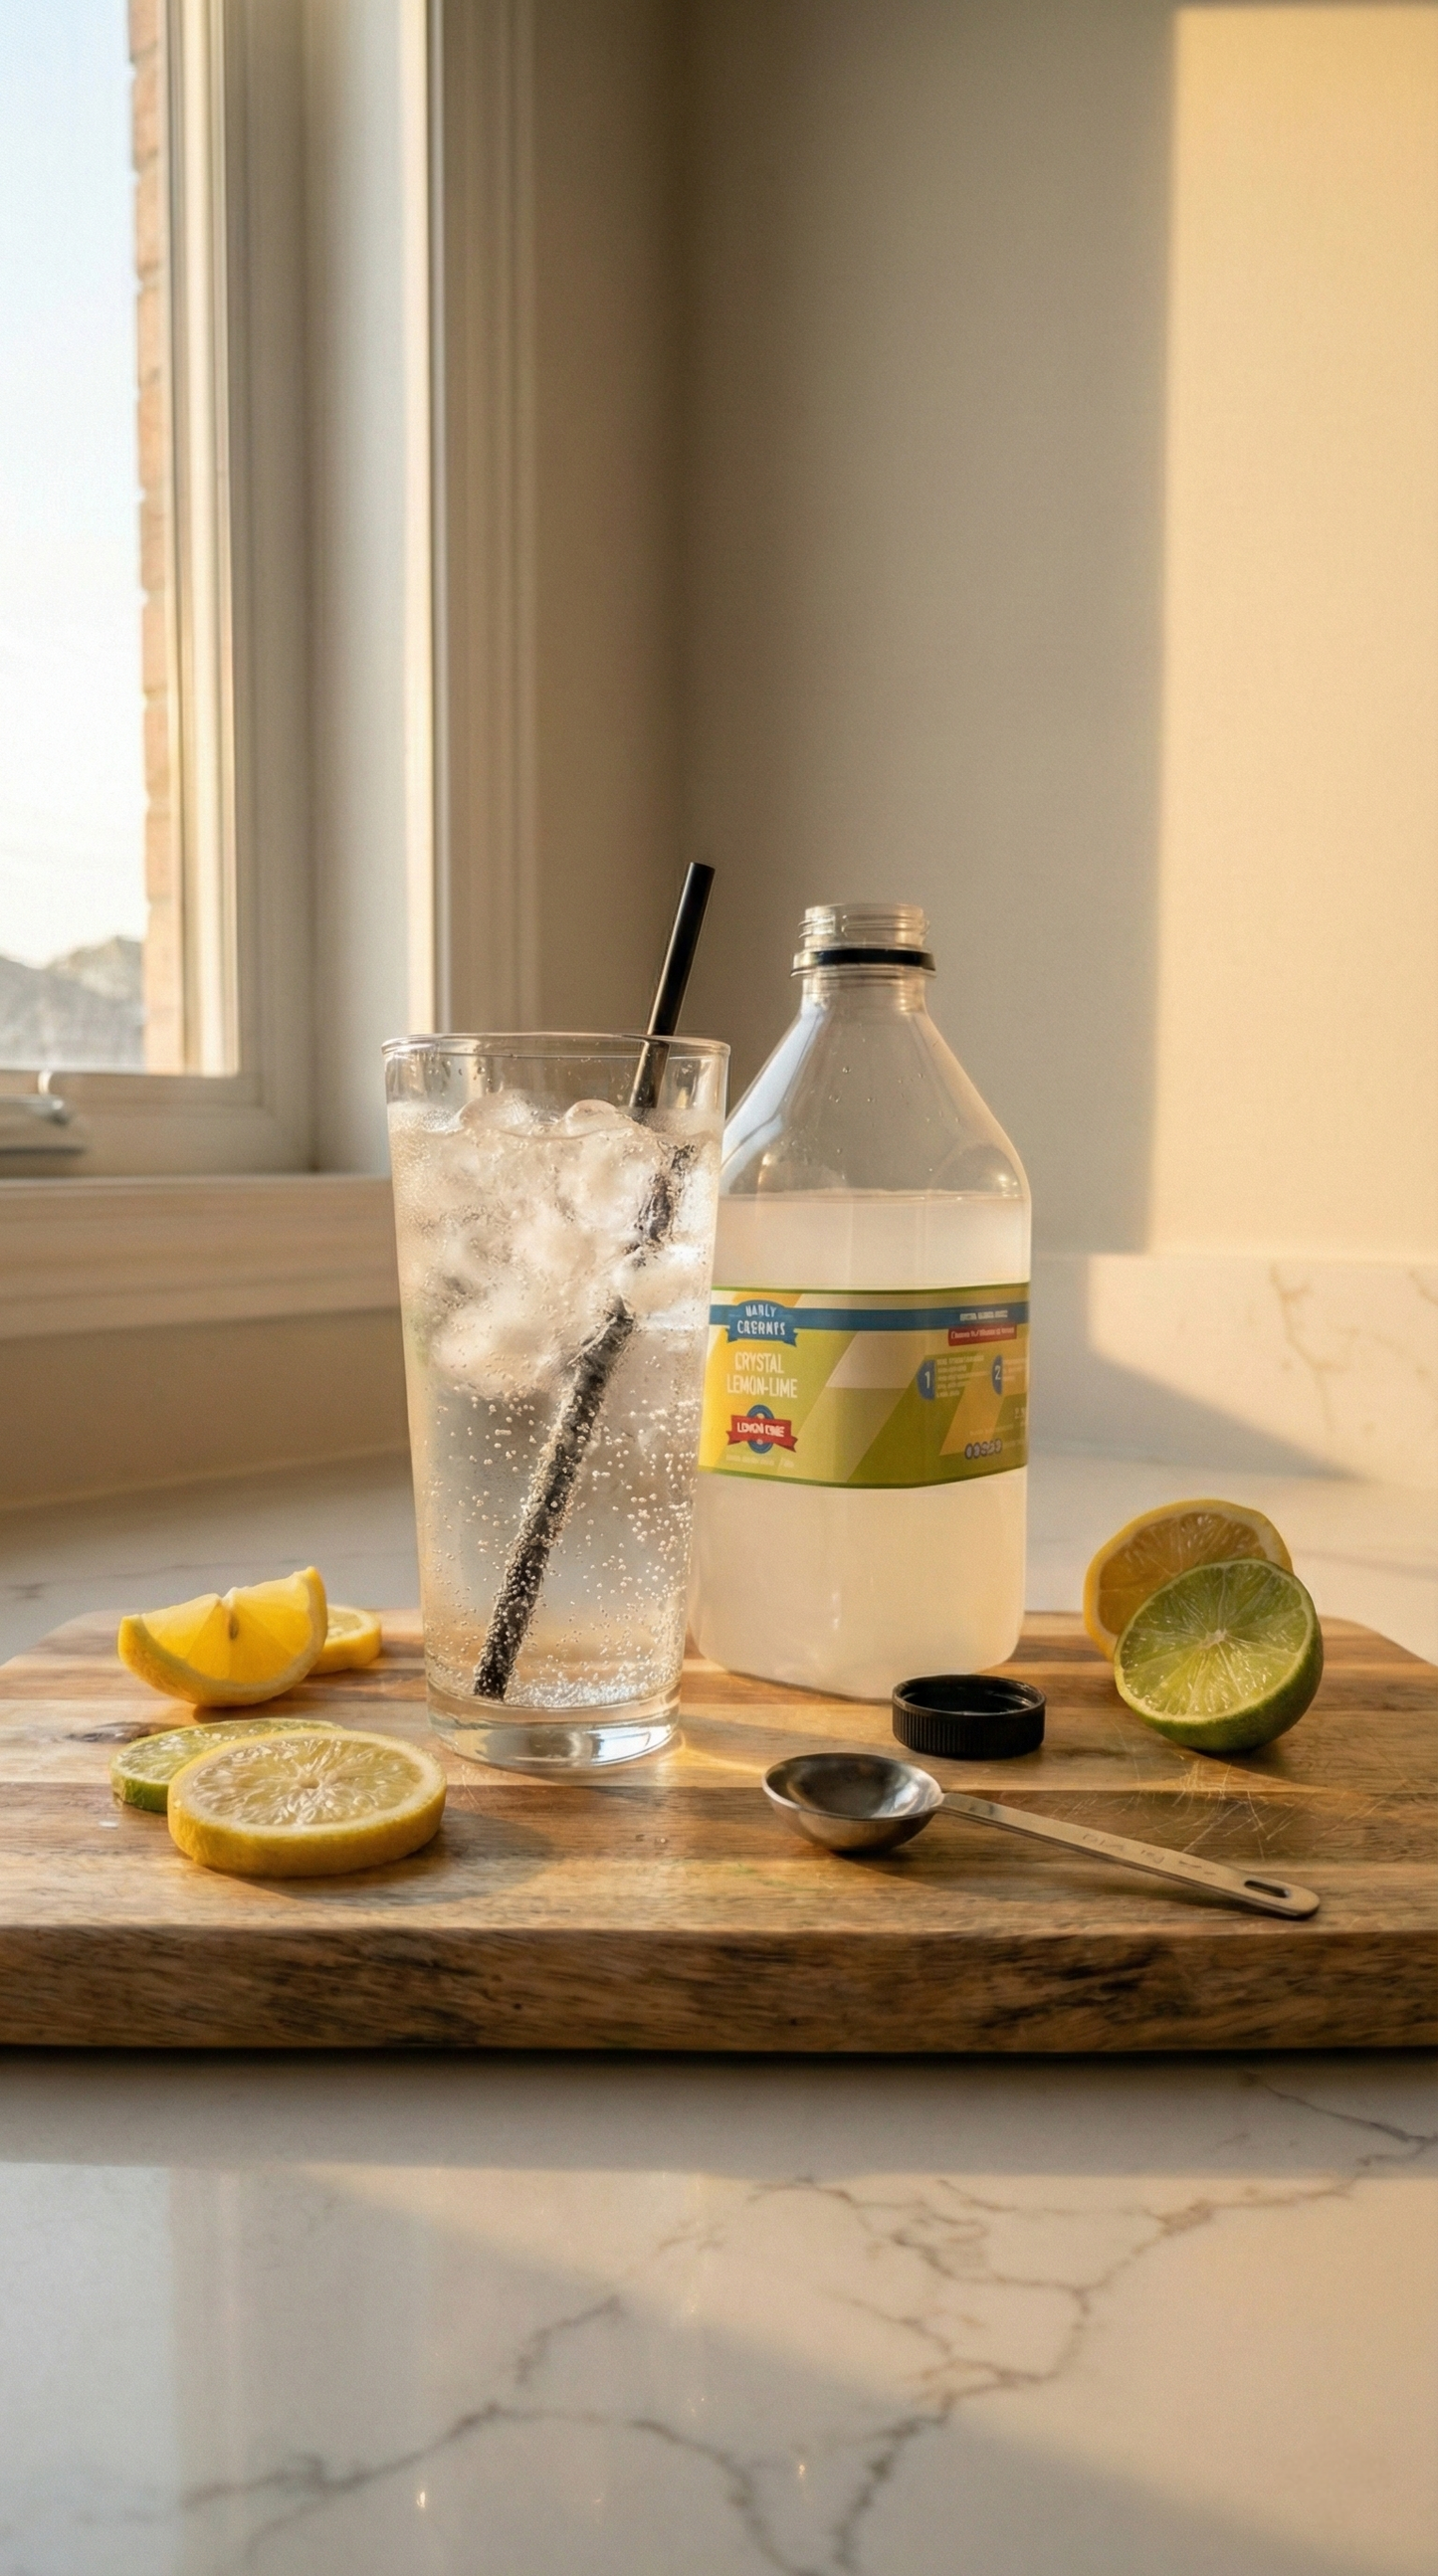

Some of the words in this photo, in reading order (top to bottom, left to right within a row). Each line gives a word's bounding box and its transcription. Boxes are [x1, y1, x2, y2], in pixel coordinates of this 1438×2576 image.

[734, 1351, 784, 1374] CRYSTAL
[994, 1364, 1001, 1380] 2
[726, 1373, 798, 1399] LEMON-LIME
[924, 1371, 930, 1389] 1
